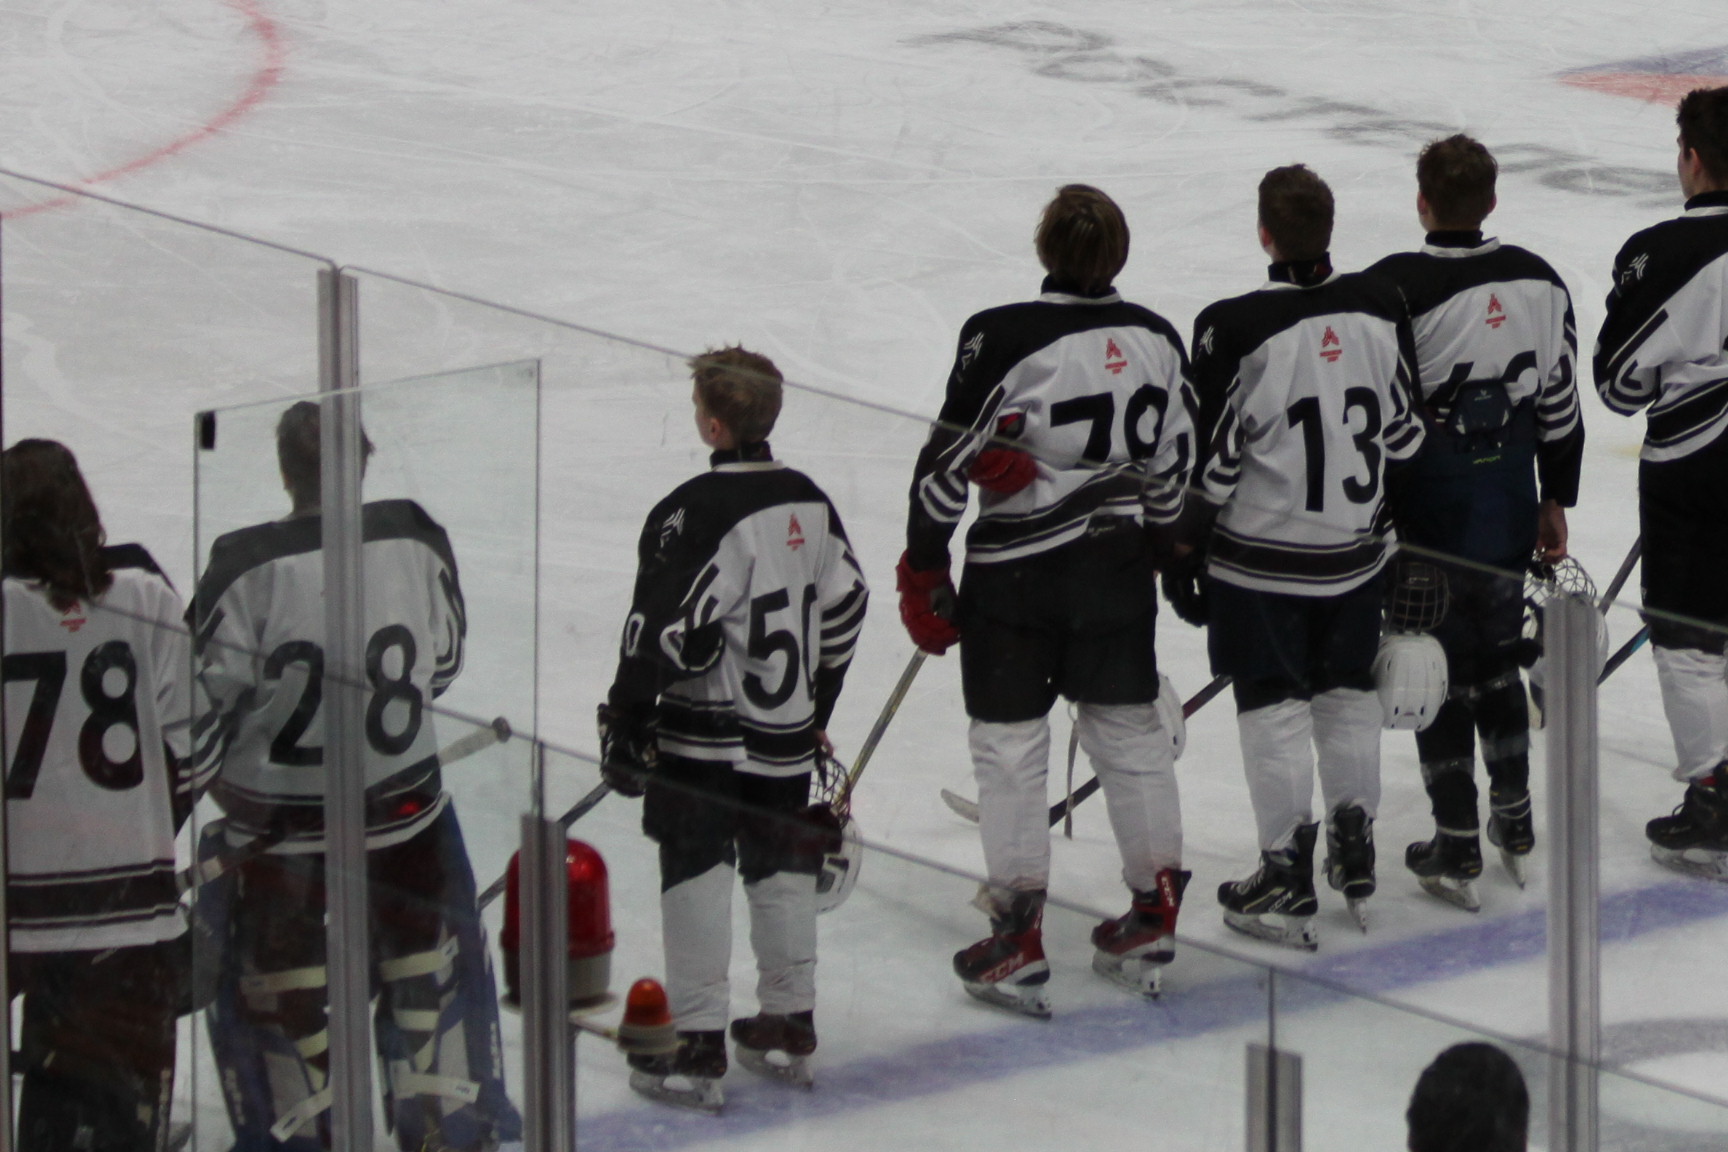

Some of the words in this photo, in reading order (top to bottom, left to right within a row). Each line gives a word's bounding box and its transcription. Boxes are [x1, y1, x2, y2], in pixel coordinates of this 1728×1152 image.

[1050, 383, 1168, 468] 70
[1287, 387, 1382, 512] 13
[3, 640, 144, 799] 78
[264, 624, 423, 766] 28
